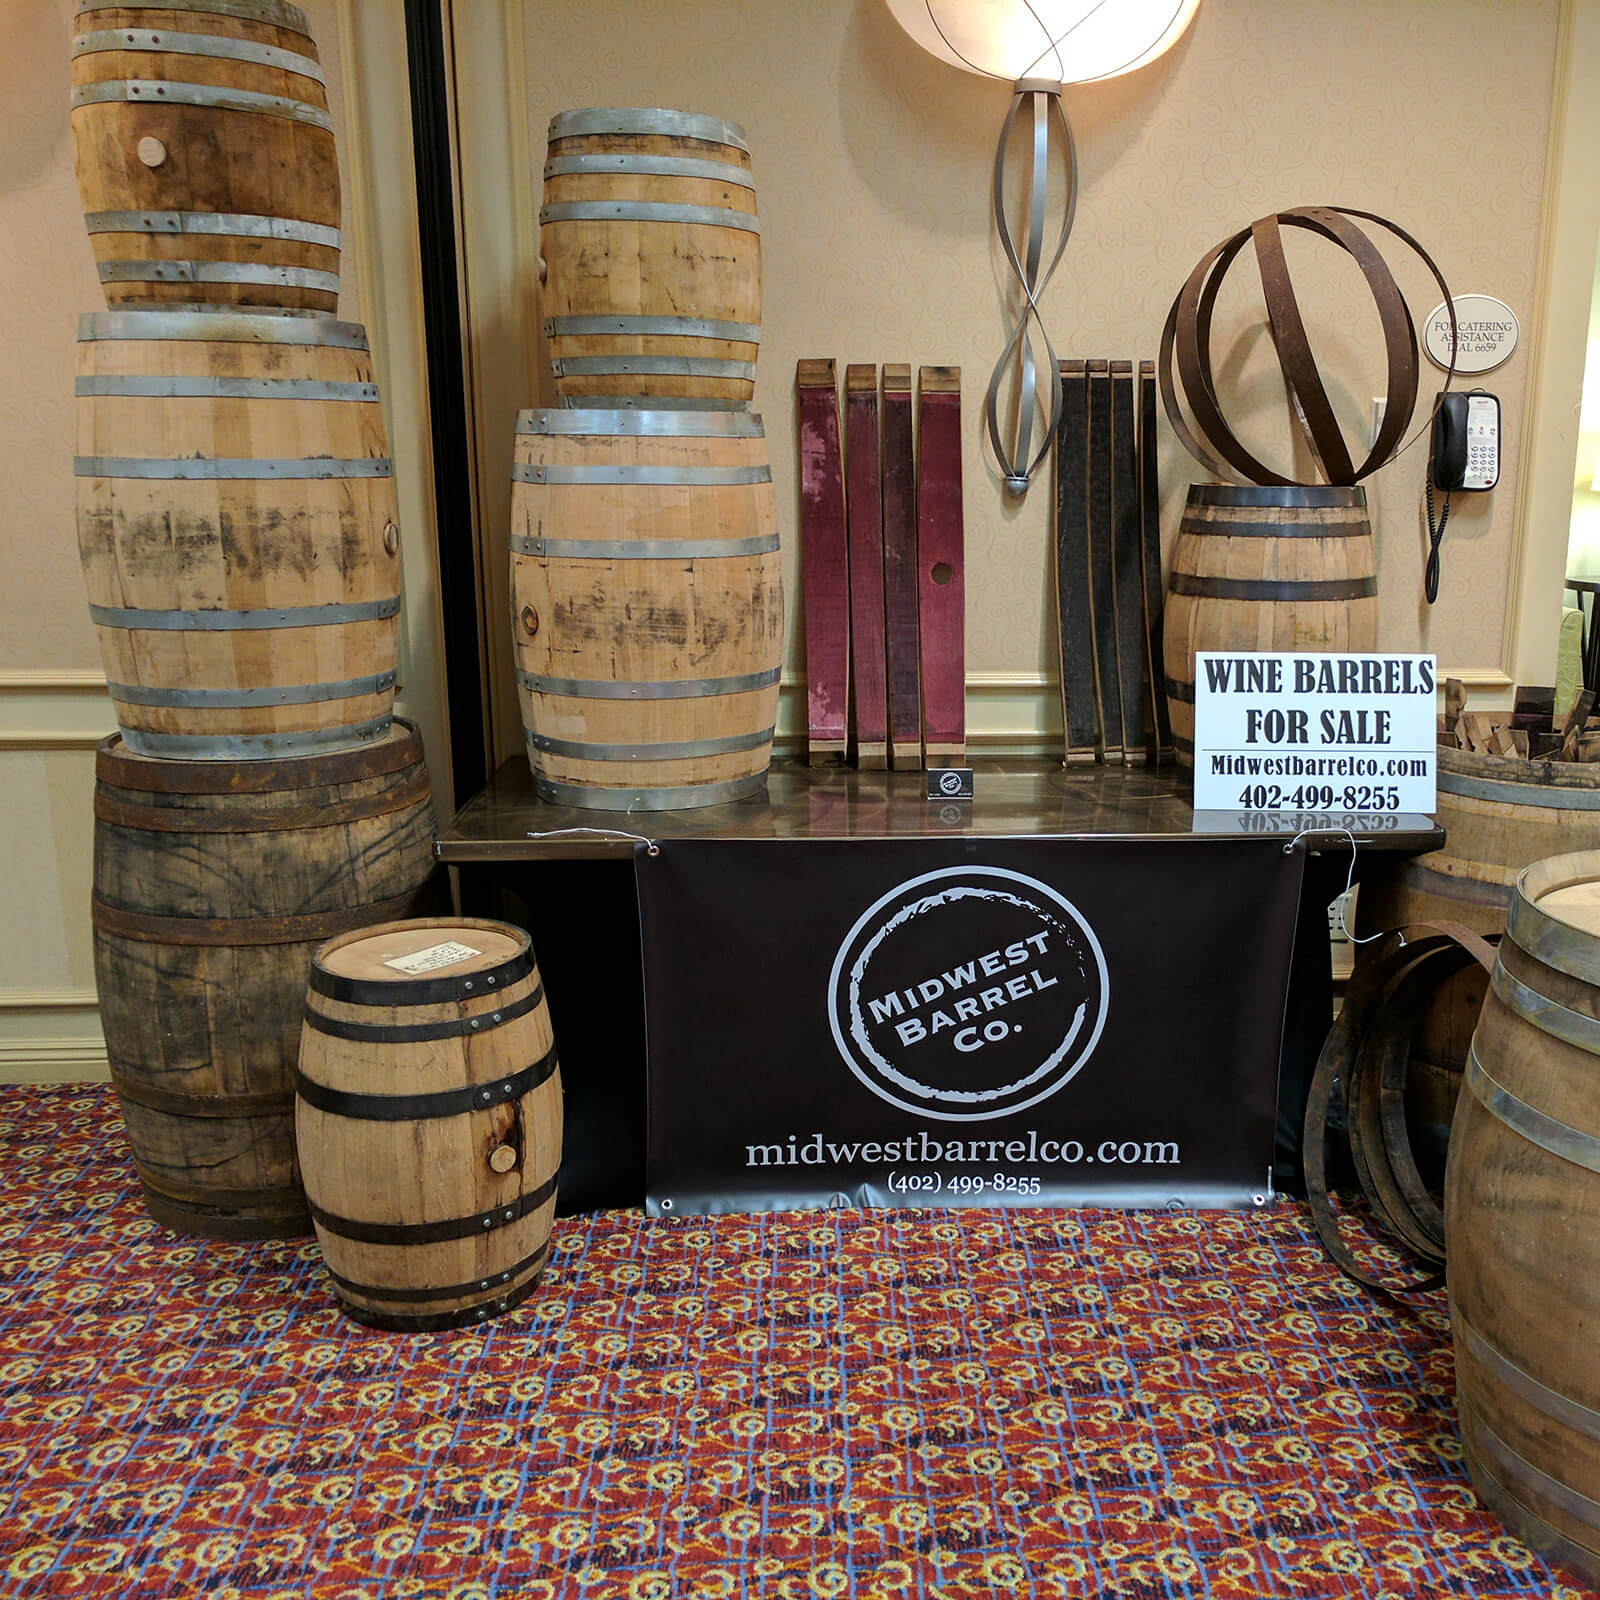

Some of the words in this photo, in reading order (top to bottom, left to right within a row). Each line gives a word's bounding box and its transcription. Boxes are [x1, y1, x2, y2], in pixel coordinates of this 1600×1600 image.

[1458, 321, 1512, 332] CATERING
[1474, 342, 1497, 352] 6659
[1204, 659, 1283, 693] WINE
[1293, 660, 1434, 695] BARRELS
[1245, 709, 1309, 744] FOR
[1320, 709, 1391, 745] SALE
[1211, 755, 1427, 777] Midwestbarrelco.com
[1238, 785, 1400, 810] 402-499-8255
[868, 930, 1050, 1025] MIDWEST
[894, 970, 1059, 1047] BARREL
[745, 1131, 1181, 1166] midwestbarrelco.com
[887, 1171, 942, 1194] (402)
[946, 1172, 1041, 1195] 499-8255
